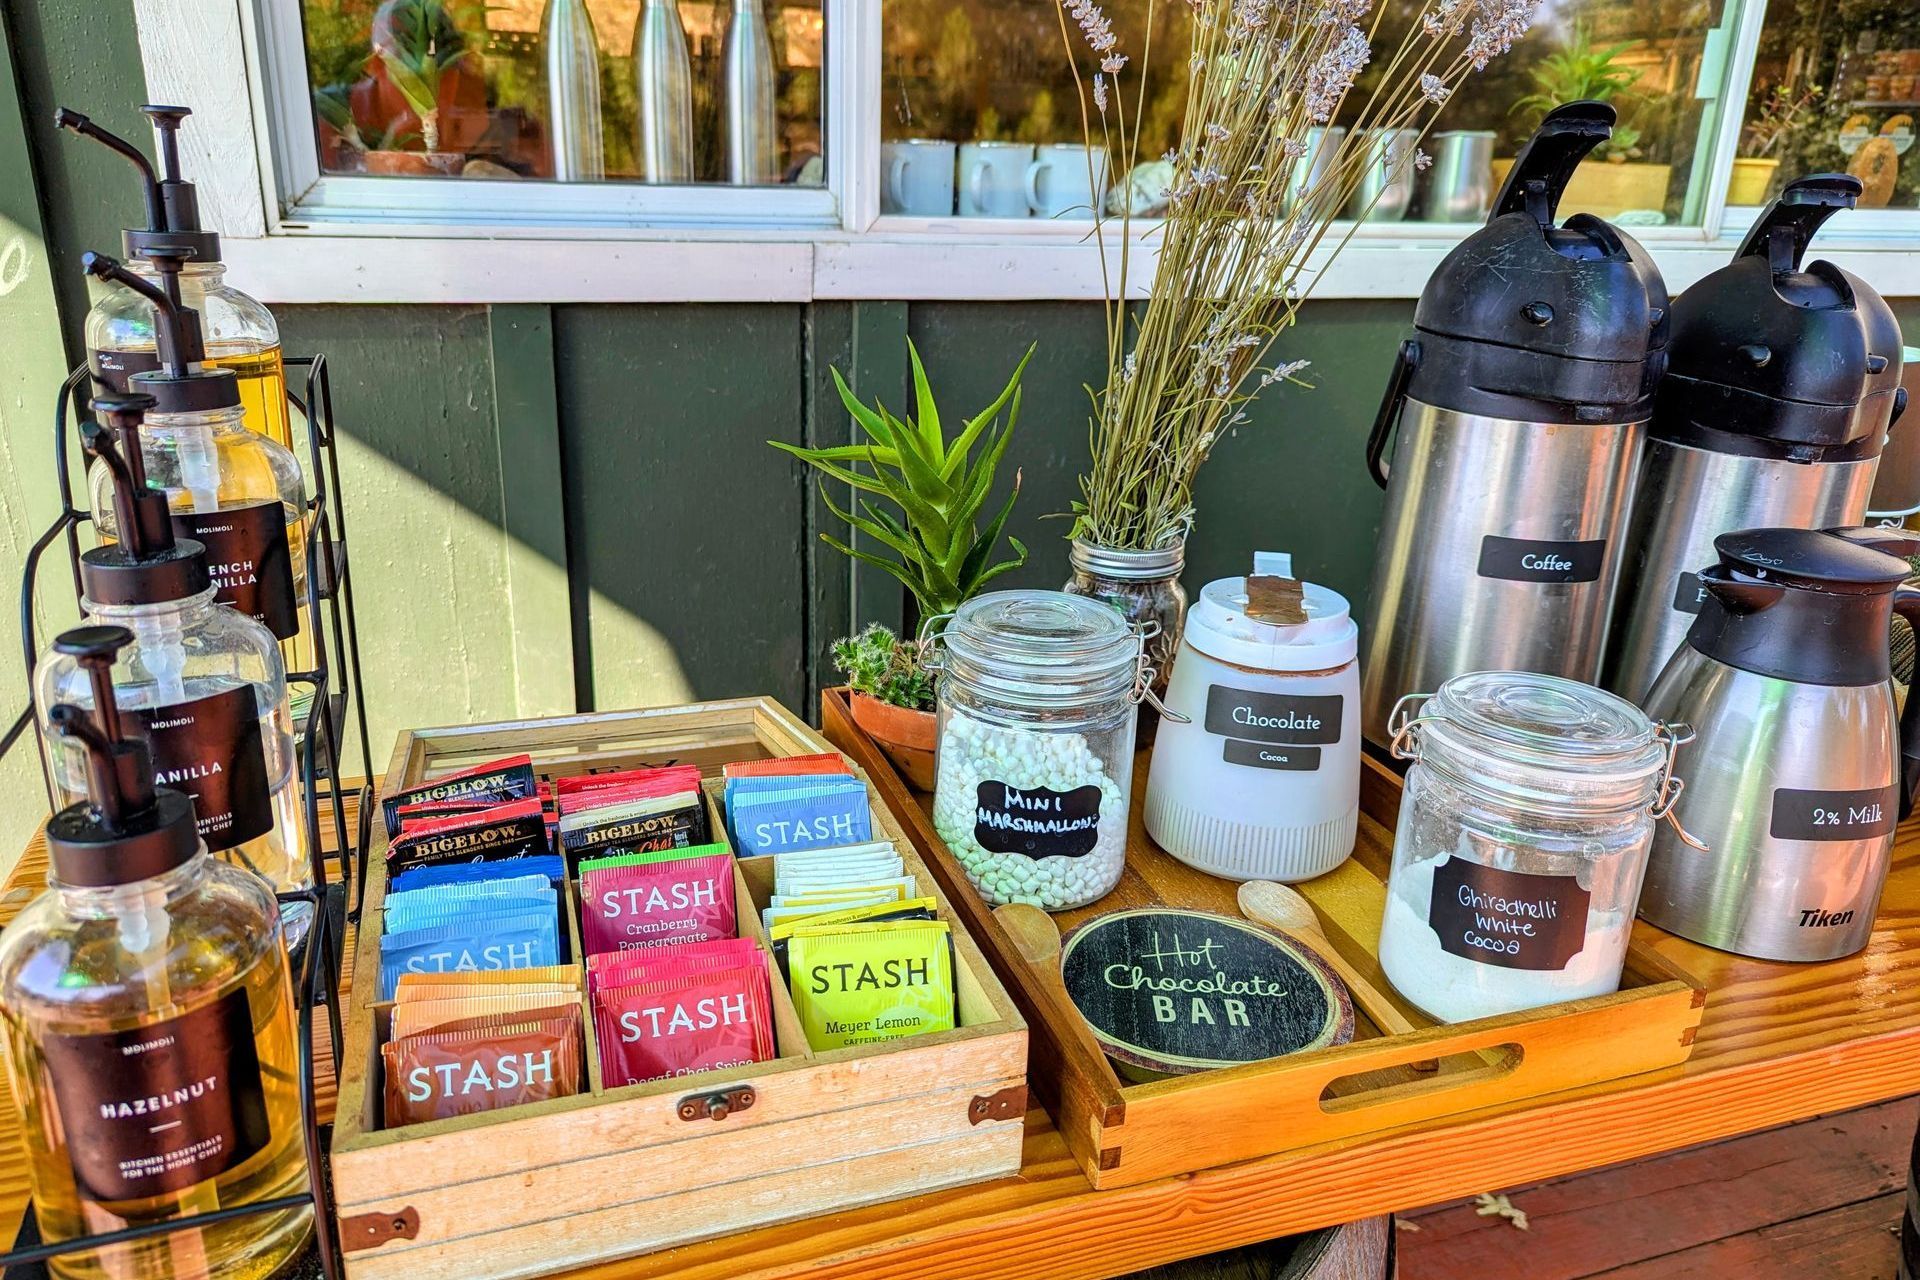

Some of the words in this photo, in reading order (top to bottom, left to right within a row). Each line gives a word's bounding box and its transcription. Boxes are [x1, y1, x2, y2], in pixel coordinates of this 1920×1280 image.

[196, 525, 233, 534] MOLIMOLI
[208, 560, 253, 576] ENCH
[1521, 554, 1573, 573] Coffee
[211, 573, 257, 589] NILLA
[151, 716, 195, 730] MOLIMOLI
[1232, 706, 1322, 731] Chocolate
[1259, 750, 1289, 764] Cocoa
[155, 762, 223, 785] ANILLA
[409, 773, 508, 804] BIGELOW
[1004, 785, 1062, 812] MINI
[212, 820, 233, 832] CHEF
[1812, 807, 1841, 826] 2%
[1847, 803, 1884, 825] Milk
[414, 825, 517, 858] BIGELOW
[586, 815, 677, 846] BIGELOW
[754, 812, 855, 849] STASH
[424, 852, 443, 862] FAMILY
[603, 878, 716, 918] STASH
[626, 918, 698, 935] Cranberry
[1475, 912, 1537, 937] White
[1798, 908, 1855, 928] Tiken
[618, 931, 708, 952] Pomegranate
[1141, 931, 1224, 971] Hot
[1464, 930, 1520, 955] Cocoa
[405, 940, 533, 974] STASH
[811, 957, 930, 996] STASH
[1103, 963, 1289, 998] Chocolate
[620, 993, 749, 1043] STASH
[1153, 996, 1252, 1028] BAR
[825, 1020, 872, 1036] Meyer
[875, 1016, 922, 1031] Lemon
[122, 1036, 175, 1056] MOLIMOLI
[408, 1050, 554, 1103] STASH
[100, 1076, 218, 1119] HAZELNUT
